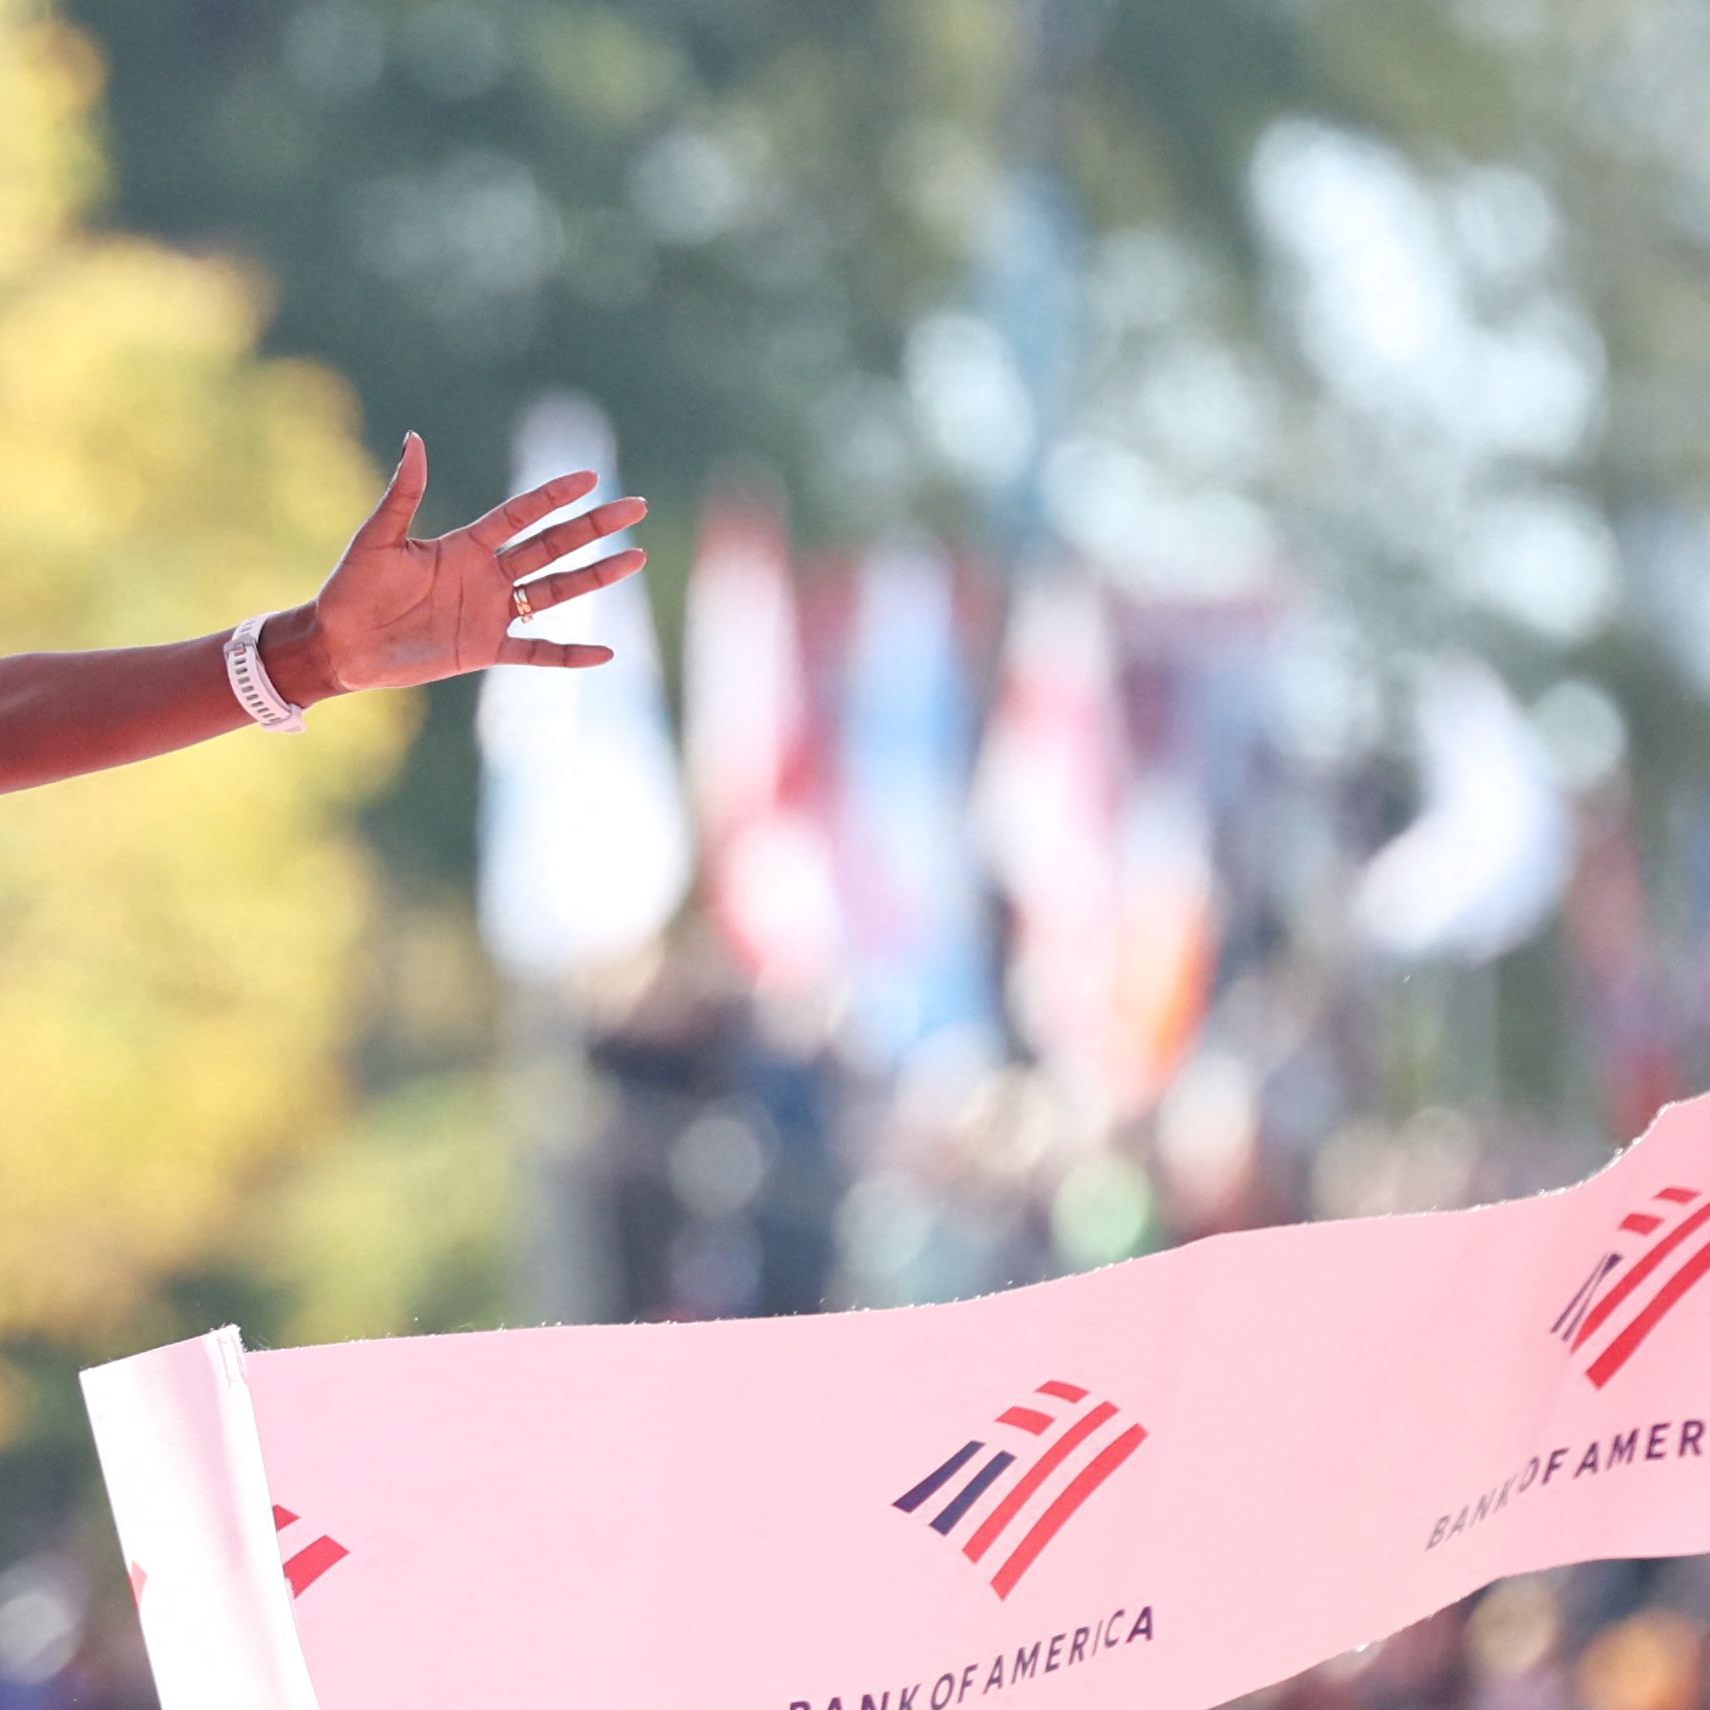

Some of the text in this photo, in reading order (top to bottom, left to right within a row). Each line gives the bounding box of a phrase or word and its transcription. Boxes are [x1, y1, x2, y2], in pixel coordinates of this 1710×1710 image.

[1424, 1420, 1704, 1551] BANK OF AMER
[982, 1606, 1154, 1695] AMERICA
